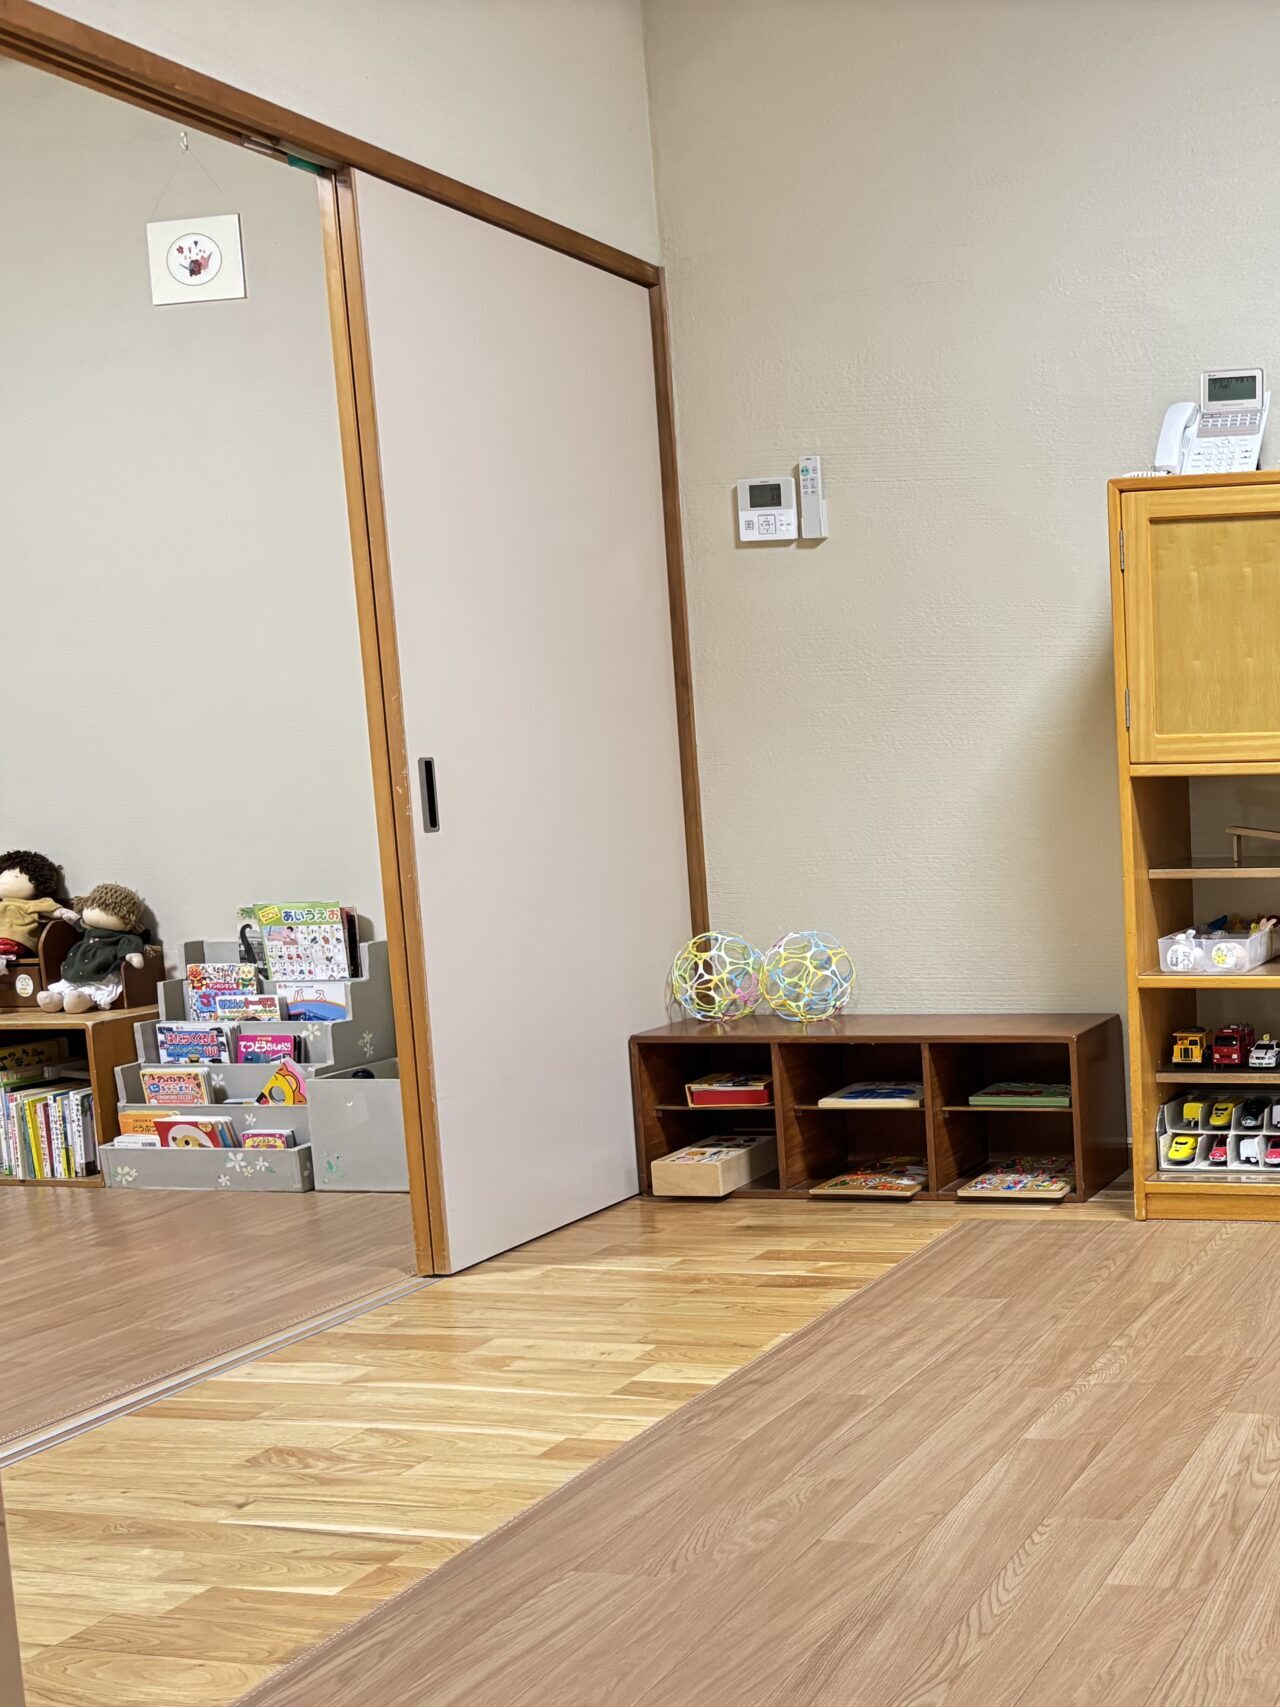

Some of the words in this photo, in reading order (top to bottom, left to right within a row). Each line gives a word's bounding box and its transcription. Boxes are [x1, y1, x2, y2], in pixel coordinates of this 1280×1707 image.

[283, 908, 340, 922] あいうえお
[166, 1032, 218, 1045] はたらくくるま
